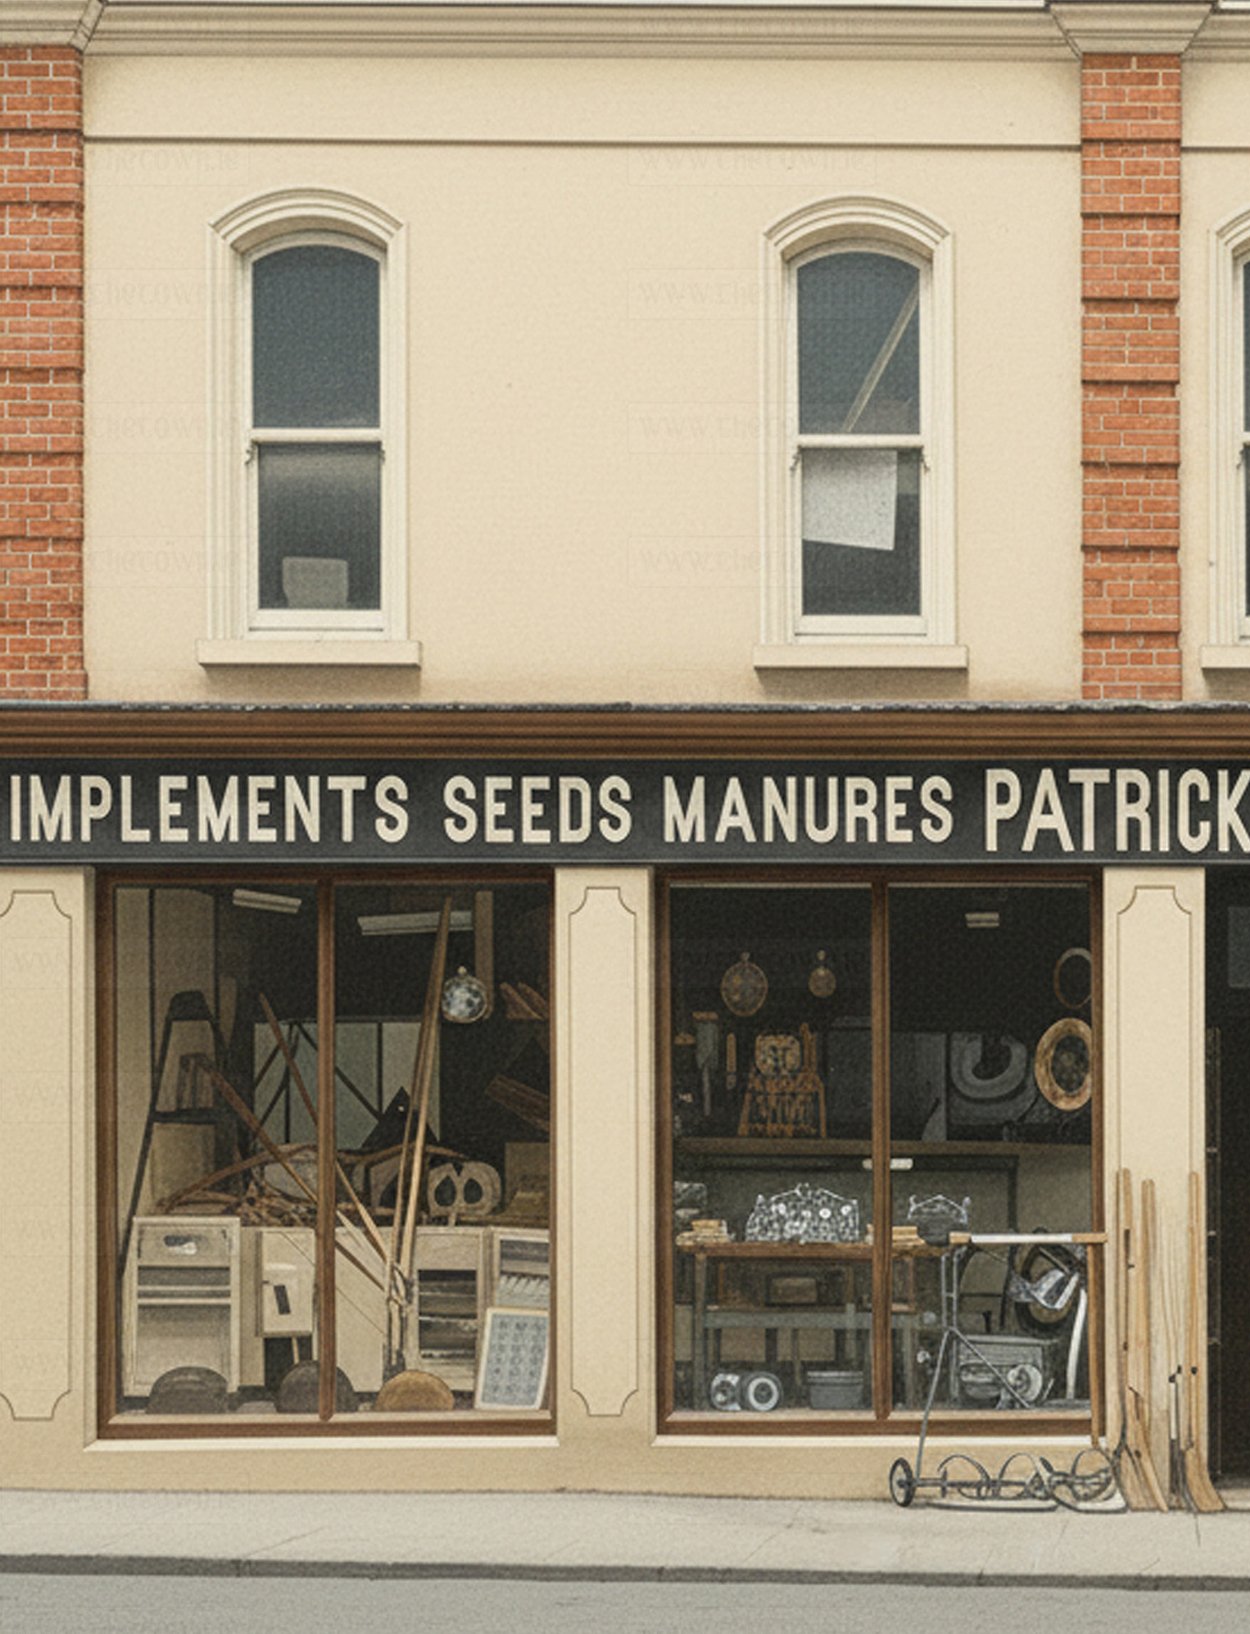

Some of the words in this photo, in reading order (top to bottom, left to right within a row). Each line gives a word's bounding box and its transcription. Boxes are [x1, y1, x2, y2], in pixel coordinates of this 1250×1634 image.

[11, 775, 408, 842] IMPLEMENTS
[444, 776, 632, 843] SEEDS
[665, 776, 952, 842] MANURES
